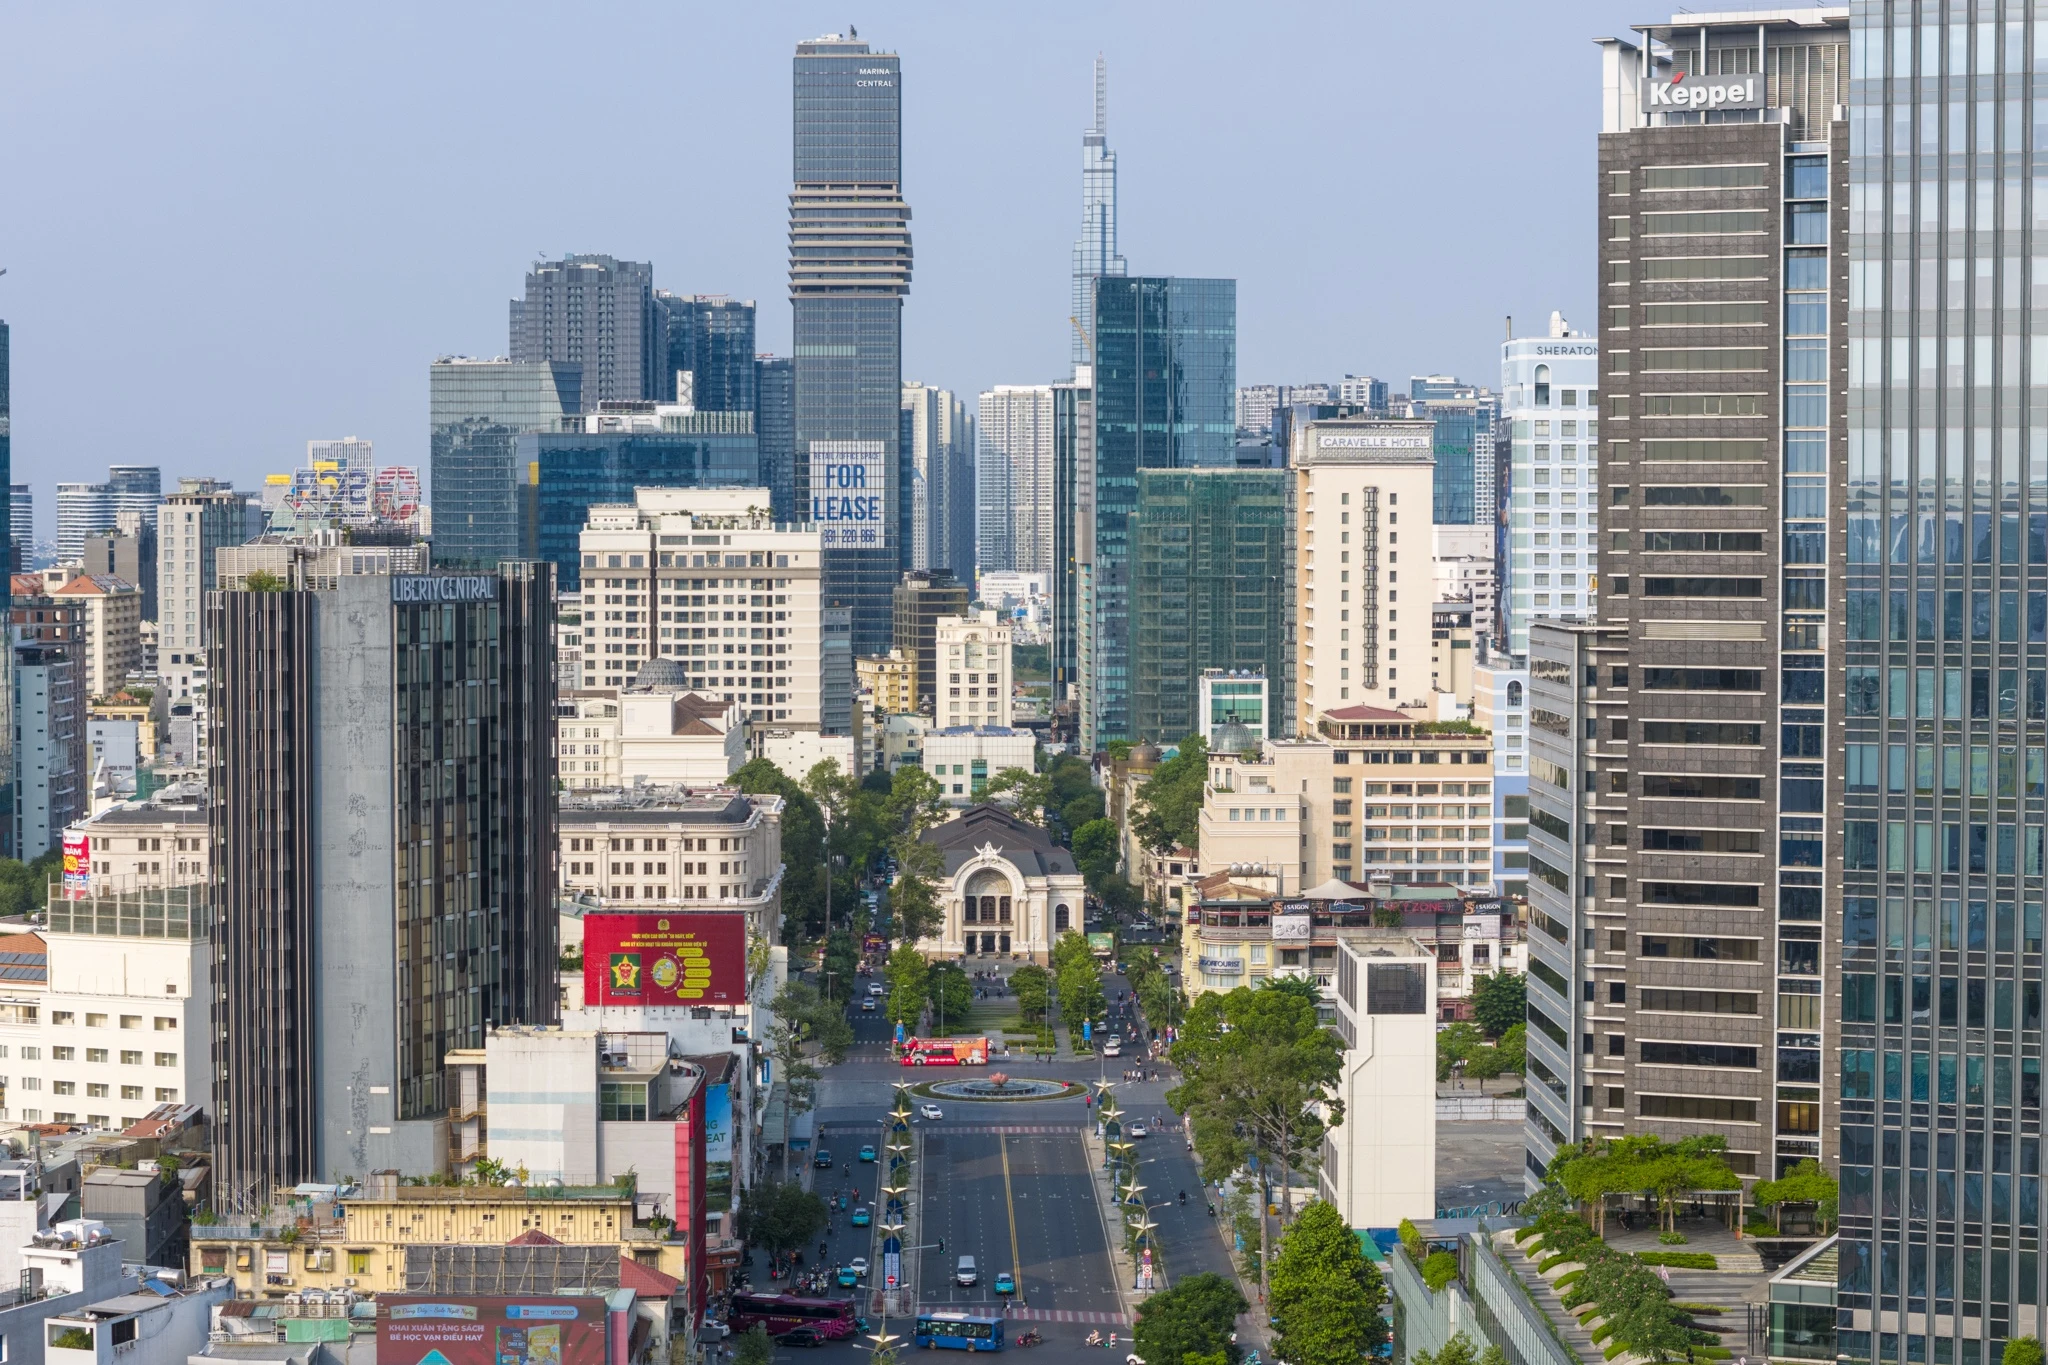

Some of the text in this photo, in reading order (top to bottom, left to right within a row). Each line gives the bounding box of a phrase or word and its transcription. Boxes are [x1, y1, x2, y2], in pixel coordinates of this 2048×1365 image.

[1650, 71, 1754, 108] Keppel
[1323, 438, 1427, 447] CARAVELLE HOTEL
[826, 464, 866, 488] FOR
[813, 496, 880, 521] LEASE
[842, 529, 856, 542] 220
[393, 575, 494, 602] LIBERTY CENTRAL
[1412, 902, 1445, 912] ZONE
[388, 1324, 409, 1332] KHAI
[411, 1324, 435, 1332] XUÂN
[461, 1323, 485, 1332] SÁCH
[403, 1334, 421, 1342] HỌC
[423, 1334, 441, 1342] VẠN
